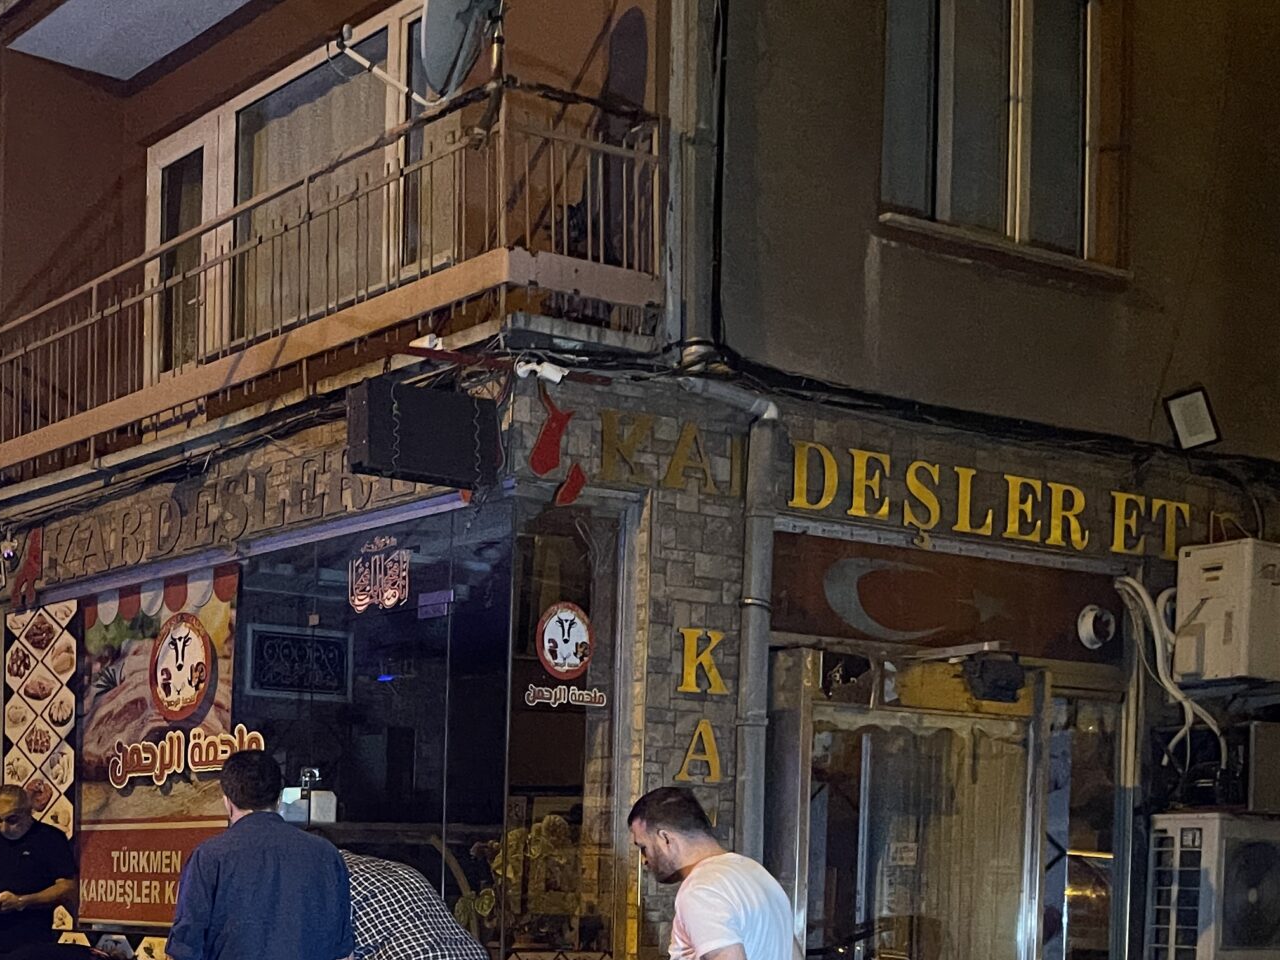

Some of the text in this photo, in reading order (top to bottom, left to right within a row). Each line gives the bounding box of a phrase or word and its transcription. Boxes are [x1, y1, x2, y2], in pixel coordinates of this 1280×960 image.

[1110, 491, 1190, 561] ET
[111, 846, 181, 873] TÜRKMEN
[79, 879, 160, 909] KARDEŞLER
